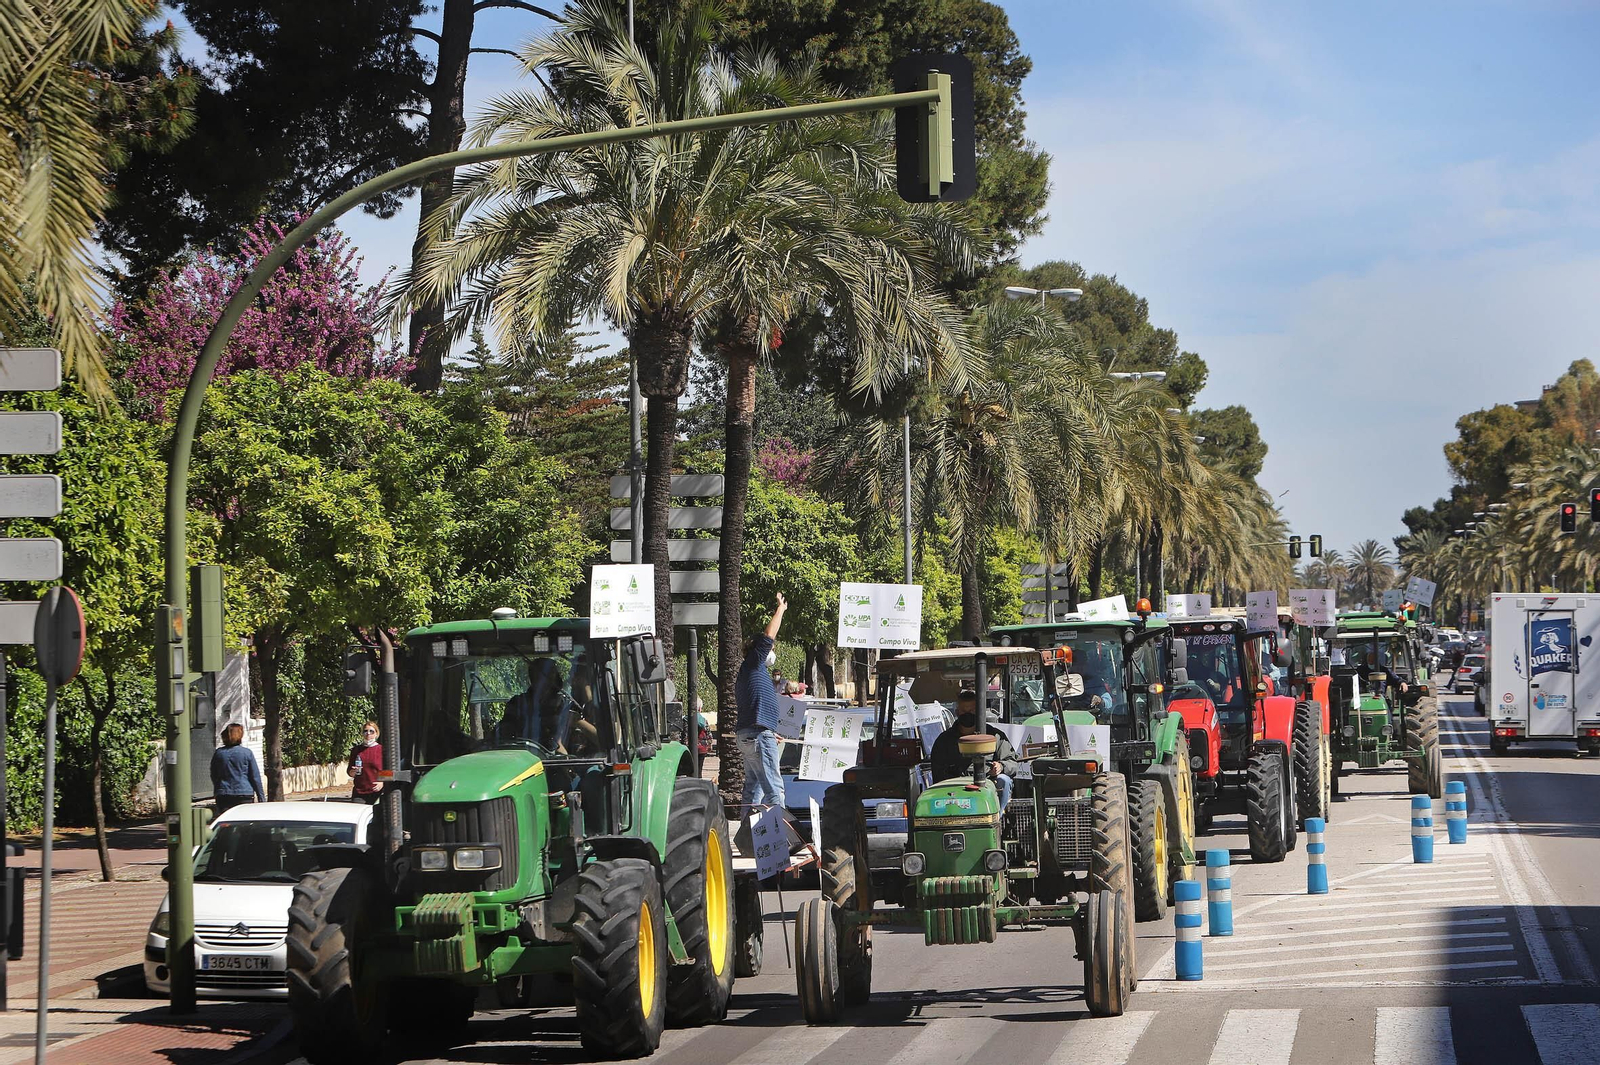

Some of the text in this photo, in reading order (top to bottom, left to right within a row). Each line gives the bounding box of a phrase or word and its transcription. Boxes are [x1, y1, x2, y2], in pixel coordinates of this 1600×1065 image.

[618, 624, 637, 634] Campo
[637, 623, 652, 632] Vivo
[879, 637, 901, 646] Campo
[902, 638, 917, 646] Vivo
[1010, 664, 1039, 674] 25676
[808, 726, 814, 734] un
[803, 744, 813, 764] Campo
[802, 764, 810, 777] Vivo
[210, 957, 269, 969] 3645 CTM
